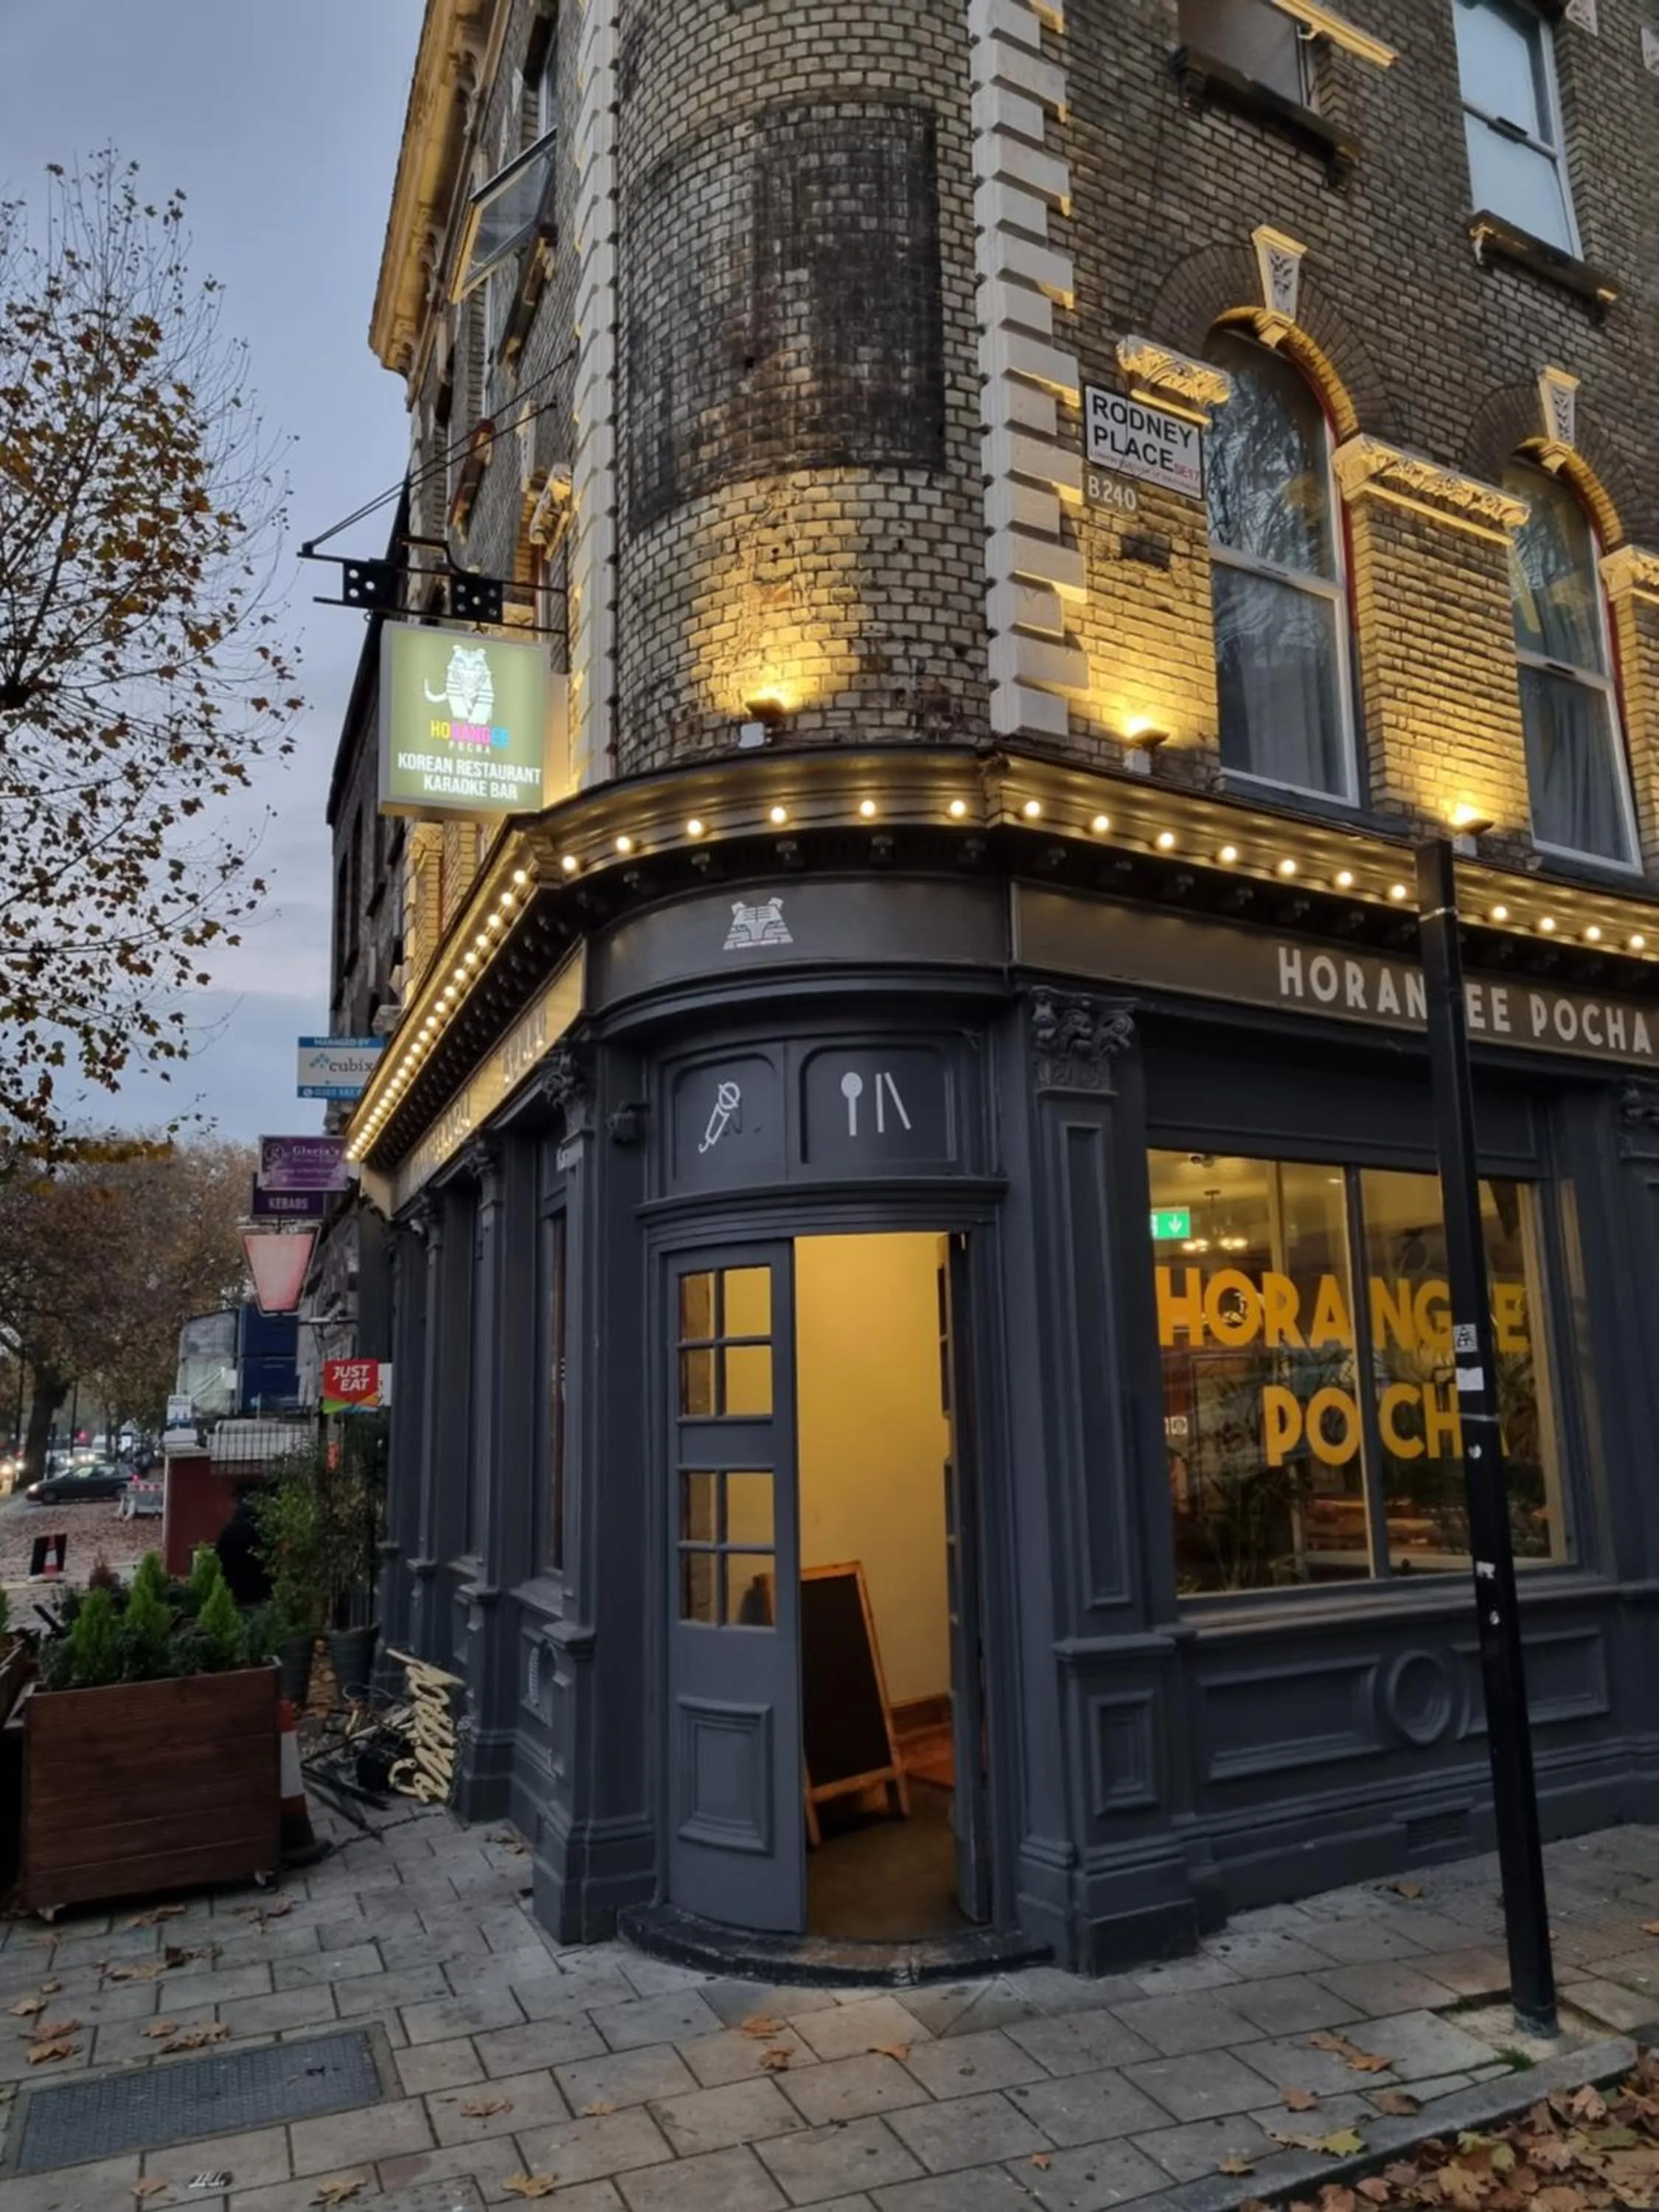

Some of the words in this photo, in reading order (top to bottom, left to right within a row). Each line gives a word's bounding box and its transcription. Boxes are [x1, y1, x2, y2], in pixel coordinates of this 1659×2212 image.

[1092, 394, 1192, 449] RODNEY
[1093, 424, 1175, 473] PLACE
[397, 751, 453, 774] KOREAN
[456, 757, 542, 785] RESTAURANT
[423, 774, 487, 797] KARAOKE
[489, 780, 518, 801] BAR
[1278, 947, 1512, 1032] HORANEE
[1530, 993, 1652, 1055] POCHA
[268, 1197, 310, 1209] KEBABS
[1155, 1265, 1531, 1353] HORANGE
[332, 1365, 371, 1380] JUST
[340, 1377, 371, 1391] EAT
[1263, 1382, 1510, 1467] POCH
